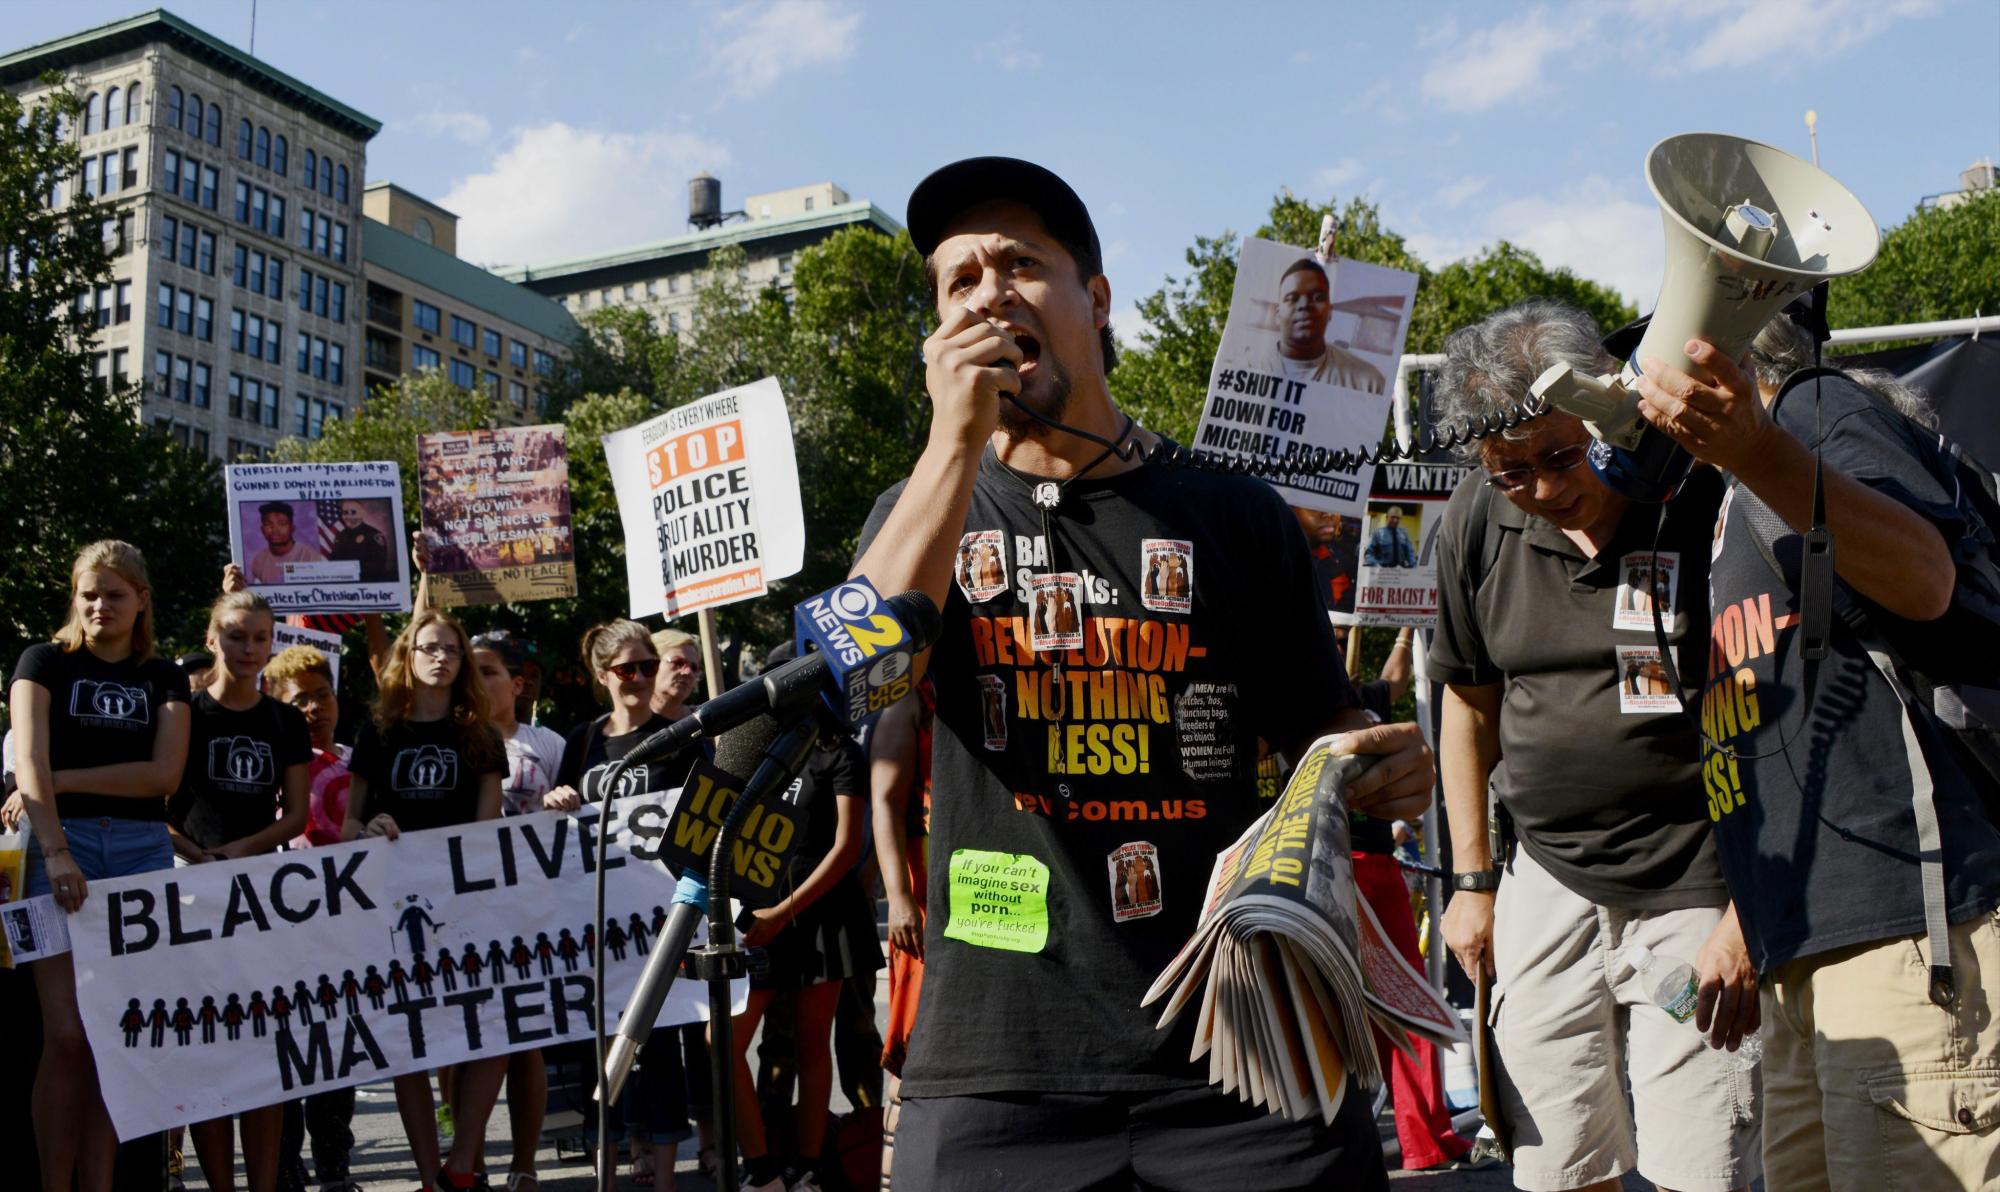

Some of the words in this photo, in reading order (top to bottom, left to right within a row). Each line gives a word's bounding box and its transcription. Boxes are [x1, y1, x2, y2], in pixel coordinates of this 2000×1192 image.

[1218, 369, 1283, 399] #SHUT
[1284, 380, 1307, 405] IT
[677, 395, 738, 429] EVERYWHERE
[1210, 396, 1268, 426] DOWN
[1267, 406, 1306, 435] FOR
[649, 425, 737, 486] STOP
[1201, 424, 1281, 457] MICHAEL
[234, 465, 302, 477] CHRISTIAN
[501, 455, 527, 467] AND
[234, 480, 280, 492] GUNNED
[284, 479, 316, 490] DOWN
[319, 479, 331, 488] IN
[333, 478, 396, 488] ARLINGTON
[653, 466, 749, 520] POLICE
[1289, 473, 1355, 498] COALITION
[444, 516, 471, 532] NOT
[533, 512, 551, 524] US
[464, 500, 491, 514] YOU
[657, 497, 751, 553] BRUTALITY
[672, 532, 758, 581] MURDER
[430, 574, 448, 585] NO
[503, 568, 521, 579] NO
[524, 564, 565, 577] PEACE
[1017, 568, 1118, 605] Sks:
[1361, 586, 1384, 605] FOR
[1387, 587, 1425, 605] RACIST
[277, 631, 295, 644] for
[297, 634, 341, 654] Sandra
[804, 598, 864, 666] NEWS
[843, 614, 903, 658] 2
[849, 666, 867, 722] NEWS
[1016, 671, 1170, 725] NOTHING
[1195, 683, 1215, 693] MEN
[1215, 685, 1227, 694] are
[1209, 721, 1216, 729] or
[1048, 724, 1150, 775] LESS!
[1181, 746, 1213, 757] WOMEN
[1222, 744, 1235, 754] Full
[1182, 759, 1207, 769] Human
[1287, 747, 1330, 813] STREETS
[447, 803, 672, 895] LIVES
[1276, 813, 1310, 852] THE
[674, 811, 781, 889] WNS
[957, 873, 1008, 889] imagine
[1010, 881, 1040, 893] sex
[962, 859, 973, 871] If
[974, 862, 1000, 874] you
[1002, 866, 1038, 878] can't
[1270, 857, 1303, 887] TO
[107, 850, 378, 956] BLACK
[971, 903, 1021, 916] porn...
[974, 890, 1022, 904] without
[957, 917, 993, 929] you're
[997, 919, 1038, 936] fucked.
[275, 976, 597, 1091] MATTER
